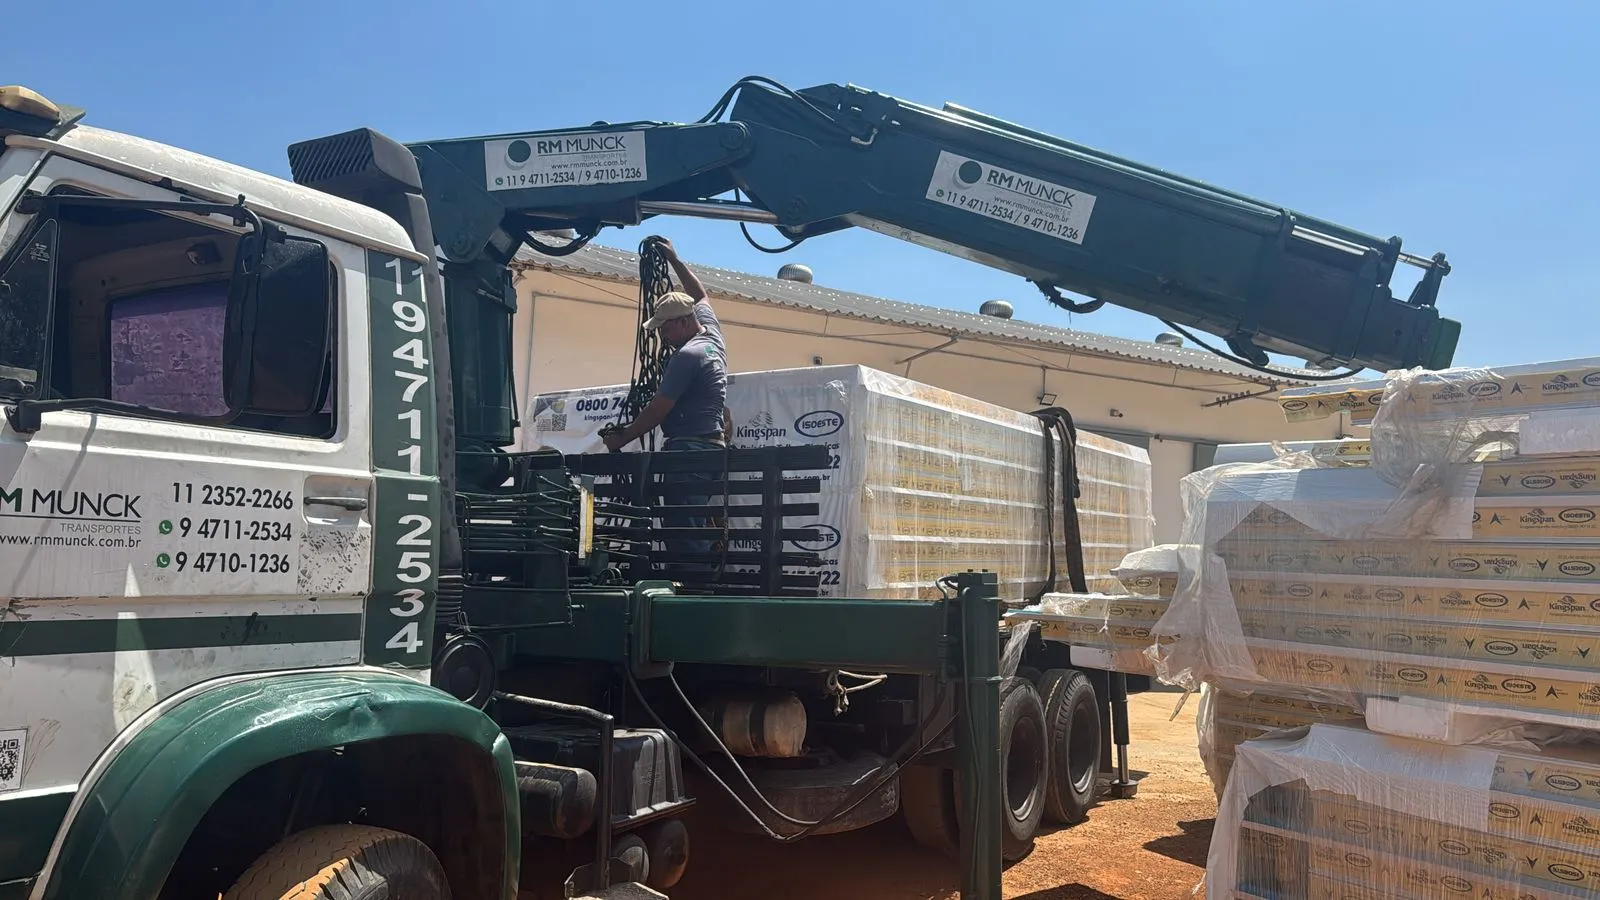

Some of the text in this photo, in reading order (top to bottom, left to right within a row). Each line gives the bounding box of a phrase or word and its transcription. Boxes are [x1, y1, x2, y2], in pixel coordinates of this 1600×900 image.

[537, 135, 626, 154] RM MUNCK
[551, 158, 627, 170] www.rmmunck.com.br
[507, 175, 517, 186] 11
[520, 174, 526, 186] 9
[528, 171, 575, 185] 4711-2534
[585, 170, 591, 181] 9
[594, 168, 642, 180] 4710-1236
[986, 169, 1076, 207] RM MUNCK
[947, 191, 957, 203] 11
[959, 195, 966, 206] 9
[967, 196, 1014, 220] 4711-2534
[1023, 215, 1030, 225] 9
[1030, 218, 1079, 240] 4710-1236
[994, 196, 1069, 223] www.rmmunck.com.br
[576, 398, 609, 412] 0800
[736, 426, 787, 440] Kingspan
[802, 418, 838, 429] ISOESTE
[31, 488, 142, 518] MUNCK
[173, 482, 293, 510] 11 2352-2266
[60, 522, 141, 535] TRANSPORTES
[179, 517, 292, 541] 9 4711-2534
[175, 551, 290, 573] 9 4710-1236
